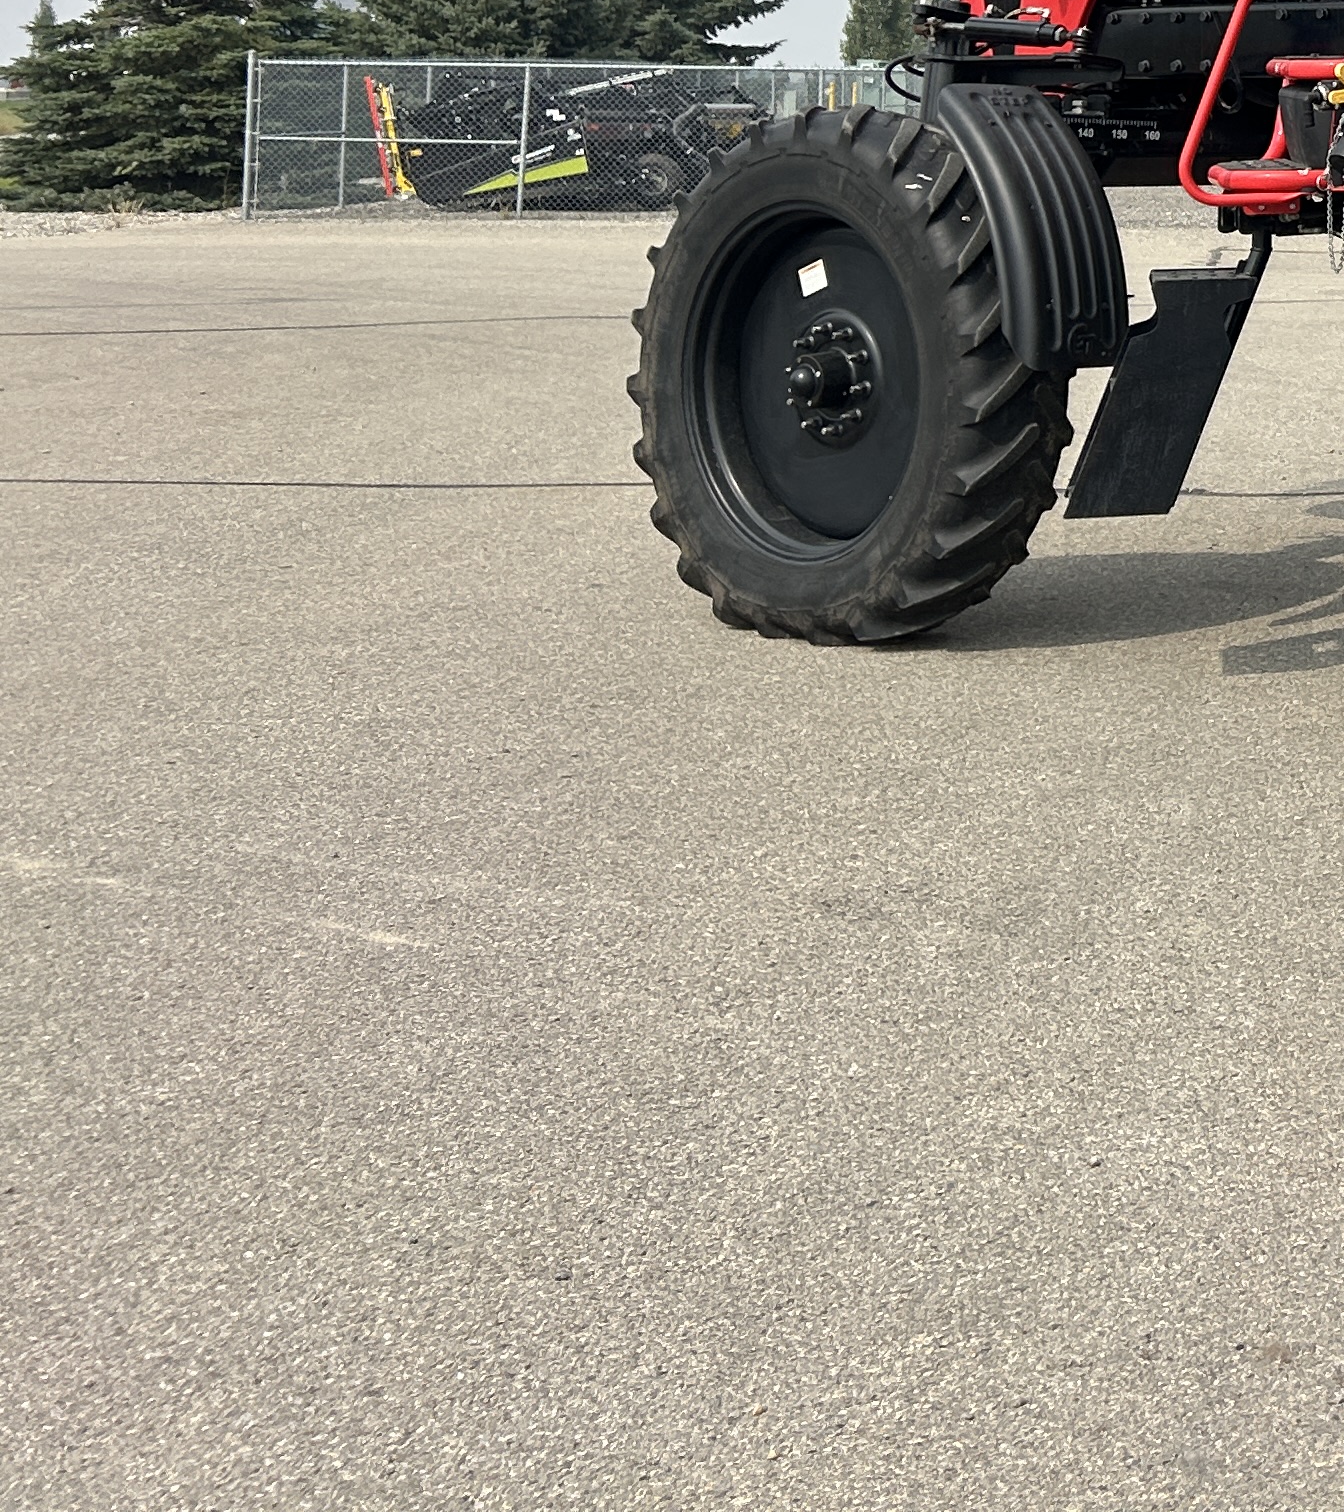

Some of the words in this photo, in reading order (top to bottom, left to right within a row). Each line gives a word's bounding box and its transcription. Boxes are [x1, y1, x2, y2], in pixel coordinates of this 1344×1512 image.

[1078, 128, 1094, 138] 140
[1111, 129, 1128, 139] 150
[1144, 130, 1160, 141] 160
